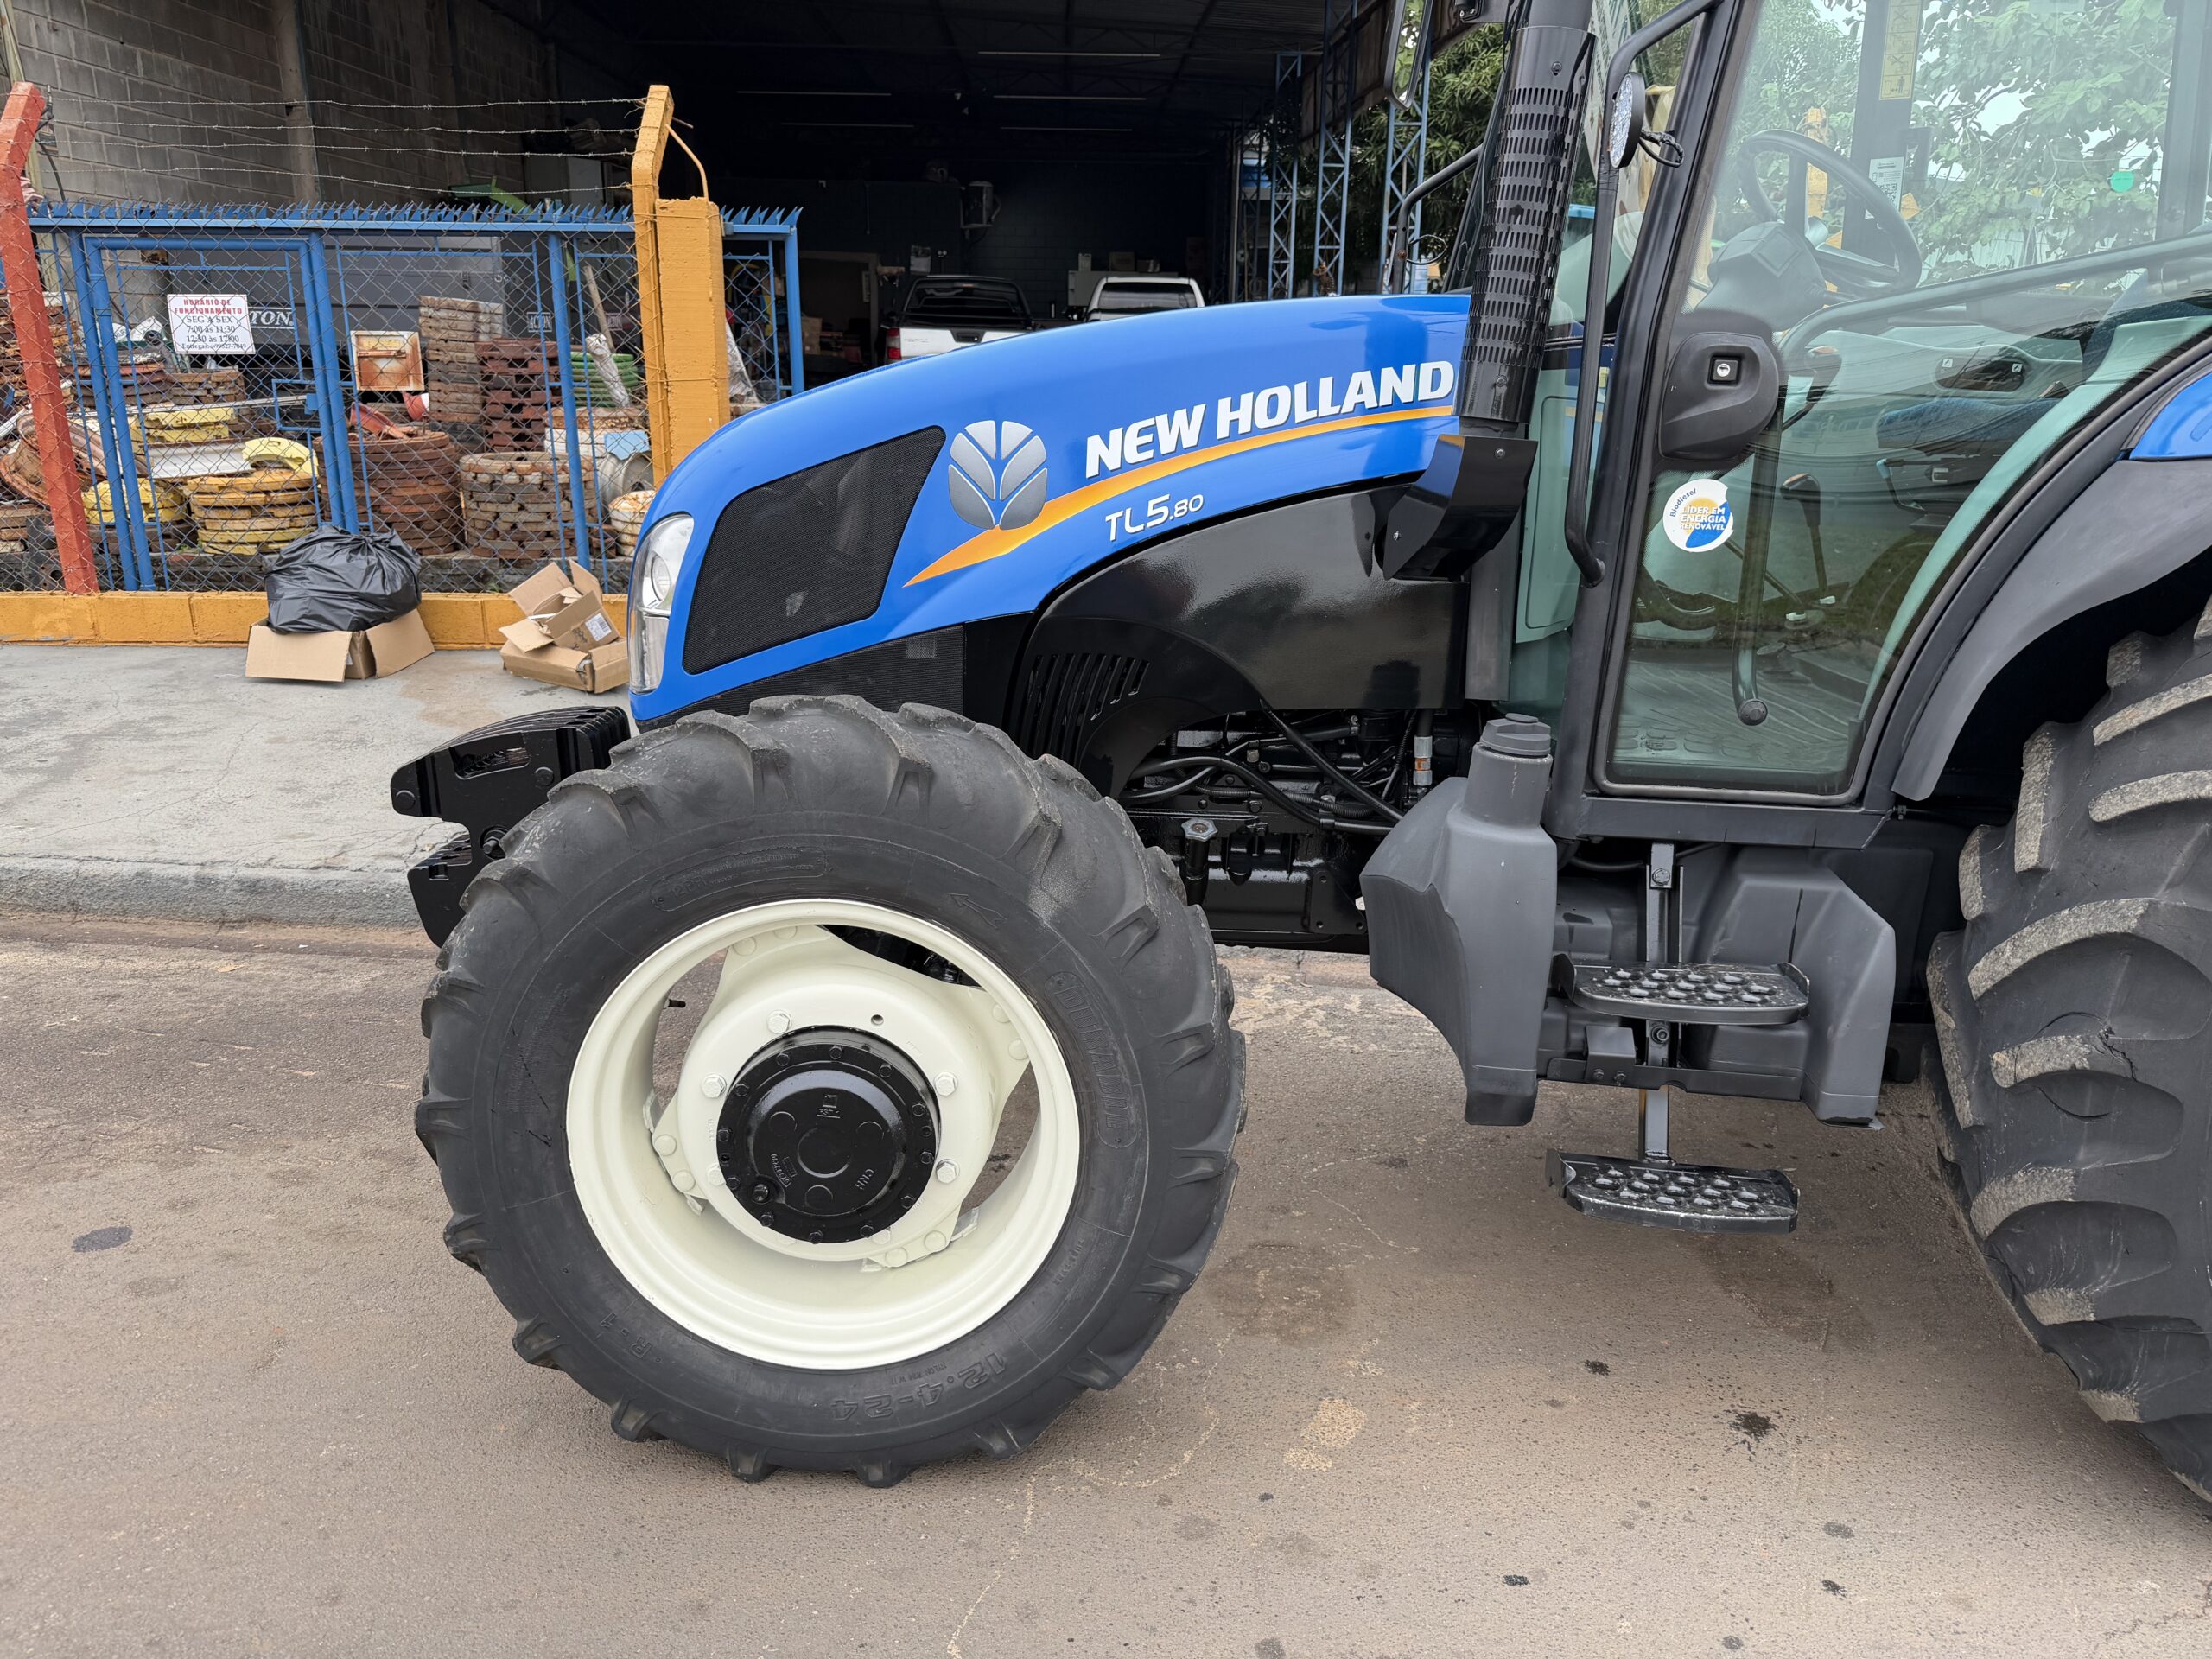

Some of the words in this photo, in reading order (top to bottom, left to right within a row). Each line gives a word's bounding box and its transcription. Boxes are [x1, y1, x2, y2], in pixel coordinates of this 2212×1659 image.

[186, 315, 205, 324] SEG
[219, 334, 240, 343] 17:00
[1085, 403, 1207, 480] NEW
[1216, 359, 1455, 442] HOLLAND
[1669, 487, 1697, 518] Biodiesel
[1681, 505, 1709, 515] LÍDER
[1680, 514, 1726, 524] ENERGIA
[830, 1352, 1008, 1422] 12.4-24
